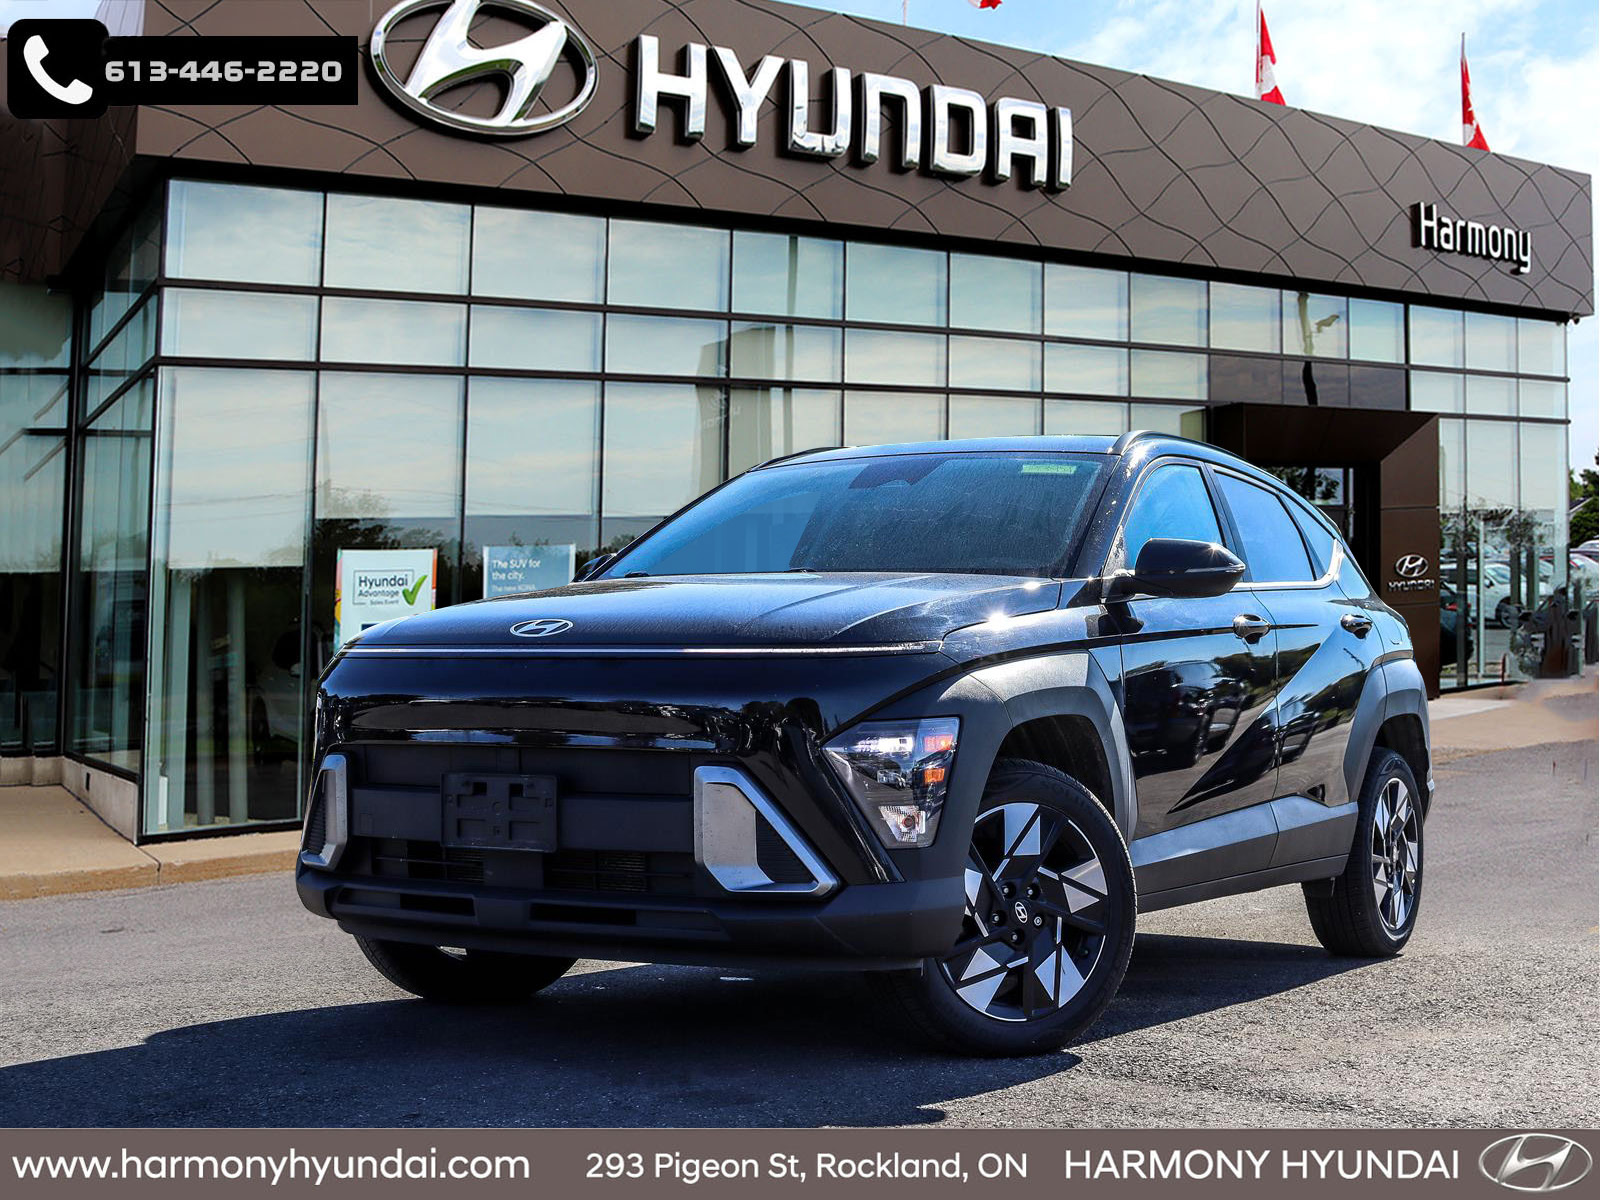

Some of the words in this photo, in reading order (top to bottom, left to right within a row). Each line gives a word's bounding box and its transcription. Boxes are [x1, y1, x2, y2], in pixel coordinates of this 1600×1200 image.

[634, 34, 1074, 192] HYUNDAI
[1418, 201, 1532, 273] Harmony
[492, 560, 508, 568] The
[509, 559, 528, 568] SUV
[528, 559, 541, 568] for
[358, 574, 408, 589] Hyundai
[492, 571, 505, 580] the
[1389, 579, 1435, 591] HYUNDAI
[358, 589, 400, 598] Advantage
